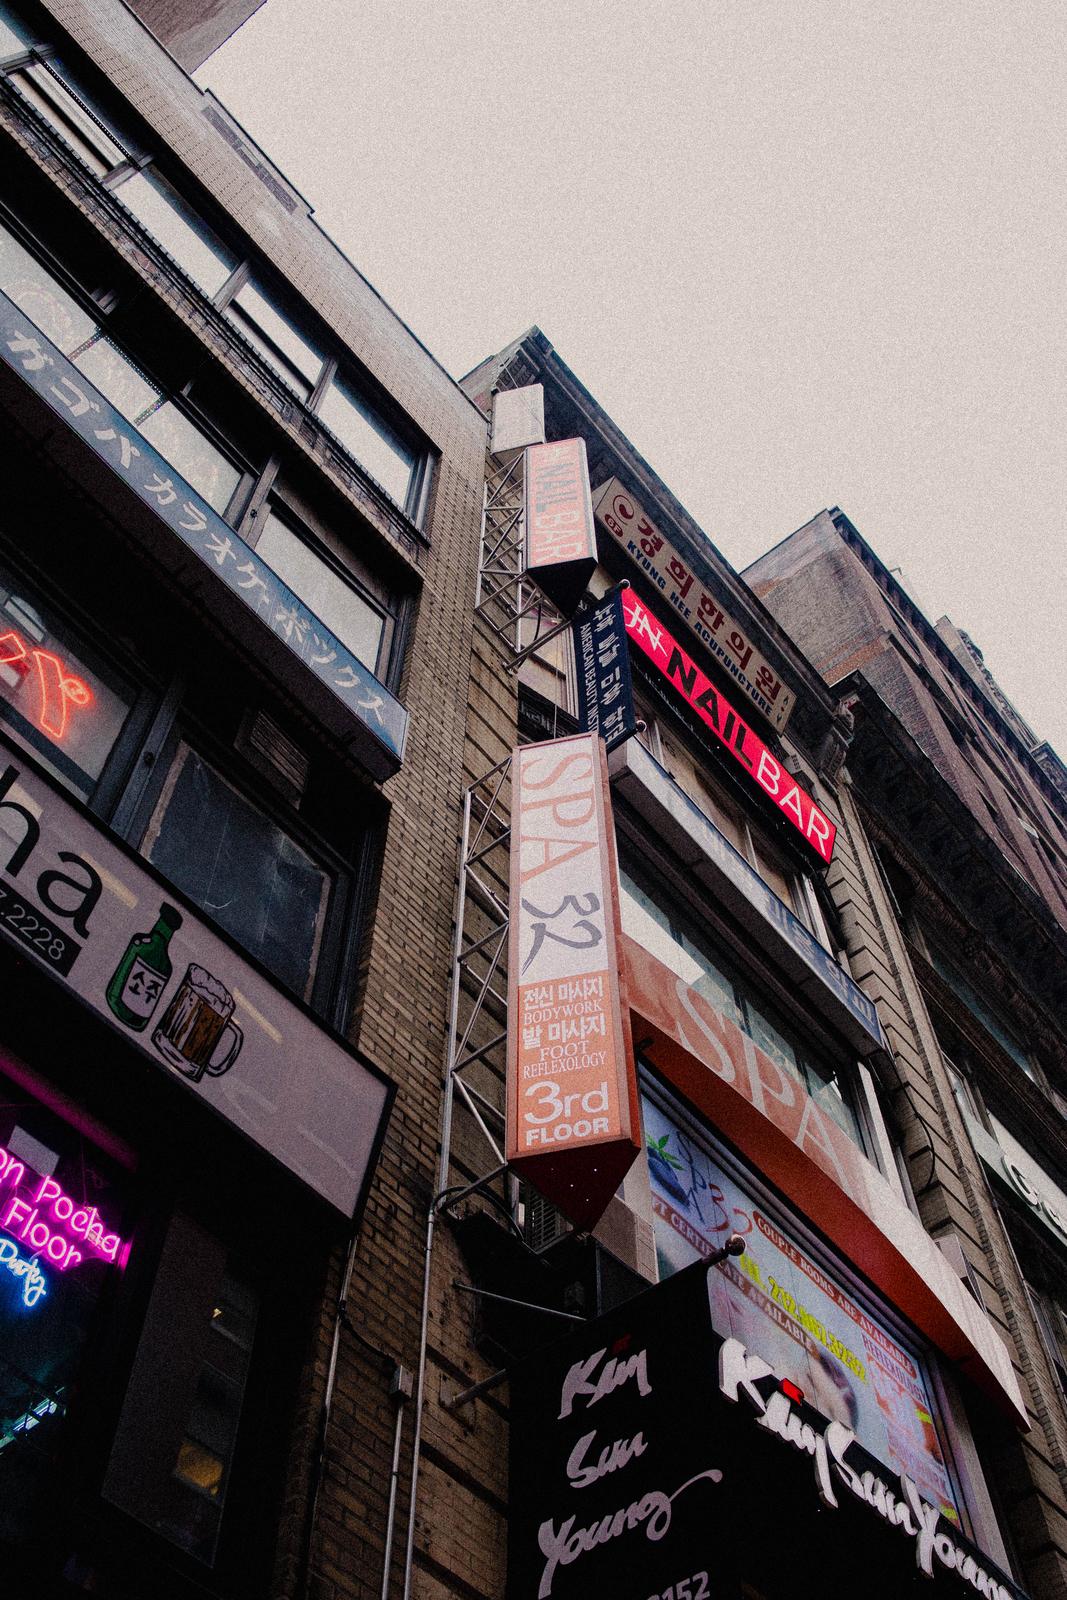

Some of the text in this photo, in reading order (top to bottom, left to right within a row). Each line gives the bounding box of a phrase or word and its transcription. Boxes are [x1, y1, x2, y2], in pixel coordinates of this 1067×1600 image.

[8, 330, 140, 468] ガゴパ
[536, 508, 583, 563] BAR
[607, 515, 622, 536] 6F
[627, 540, 773, 716] KYUNG HEE ACUPUNCTURE
[638, 518, 782, 704] 경희한의원
[580, 622, 596, 671] AMERICAN
[585, 667, 598, 707] BEAUTY
[666, 646, 753, 770] NAIL
[757, 750, 830, 856] BAR
[521, 752, 599, 884] SPA
[521, 892, 602, 976] 32
[128, 971, 162, 1005] 소주
[523, 999, 603, 1026] BODYWORK
[524, 976, 604, 1011] 전신 마사지
[523, 1014, 606, 1050] 발 마사지
[540, 1040, 590, 1062] FOOT
[523, 1051, 607, 1080] REFLEXOLOGY
[675, 978, 855, 1202] SPA
[524, 1080, 609, 1125] 3rd
[526, 1117, 609, 1147] FLOOR
[4, 1197, 82, 1268] Floor
[35, 1175, 121, 1261] Pocha
[757, 1217, 798, 1263] COUPLE
[800, 1257, 835, 1297] ROOMS
[838, 1293, 858, 1319] ARE
[859, 1317, 914, 1375] AVAILABLE
[557, 1334, 652, 1420] Kim
[566, 1429, 648, 1488] Sun
[718, 1337, 839, 1509] Kim
[825, 1420, 918, 1536] Sun
[538, 1469, 723, 1600] Young
